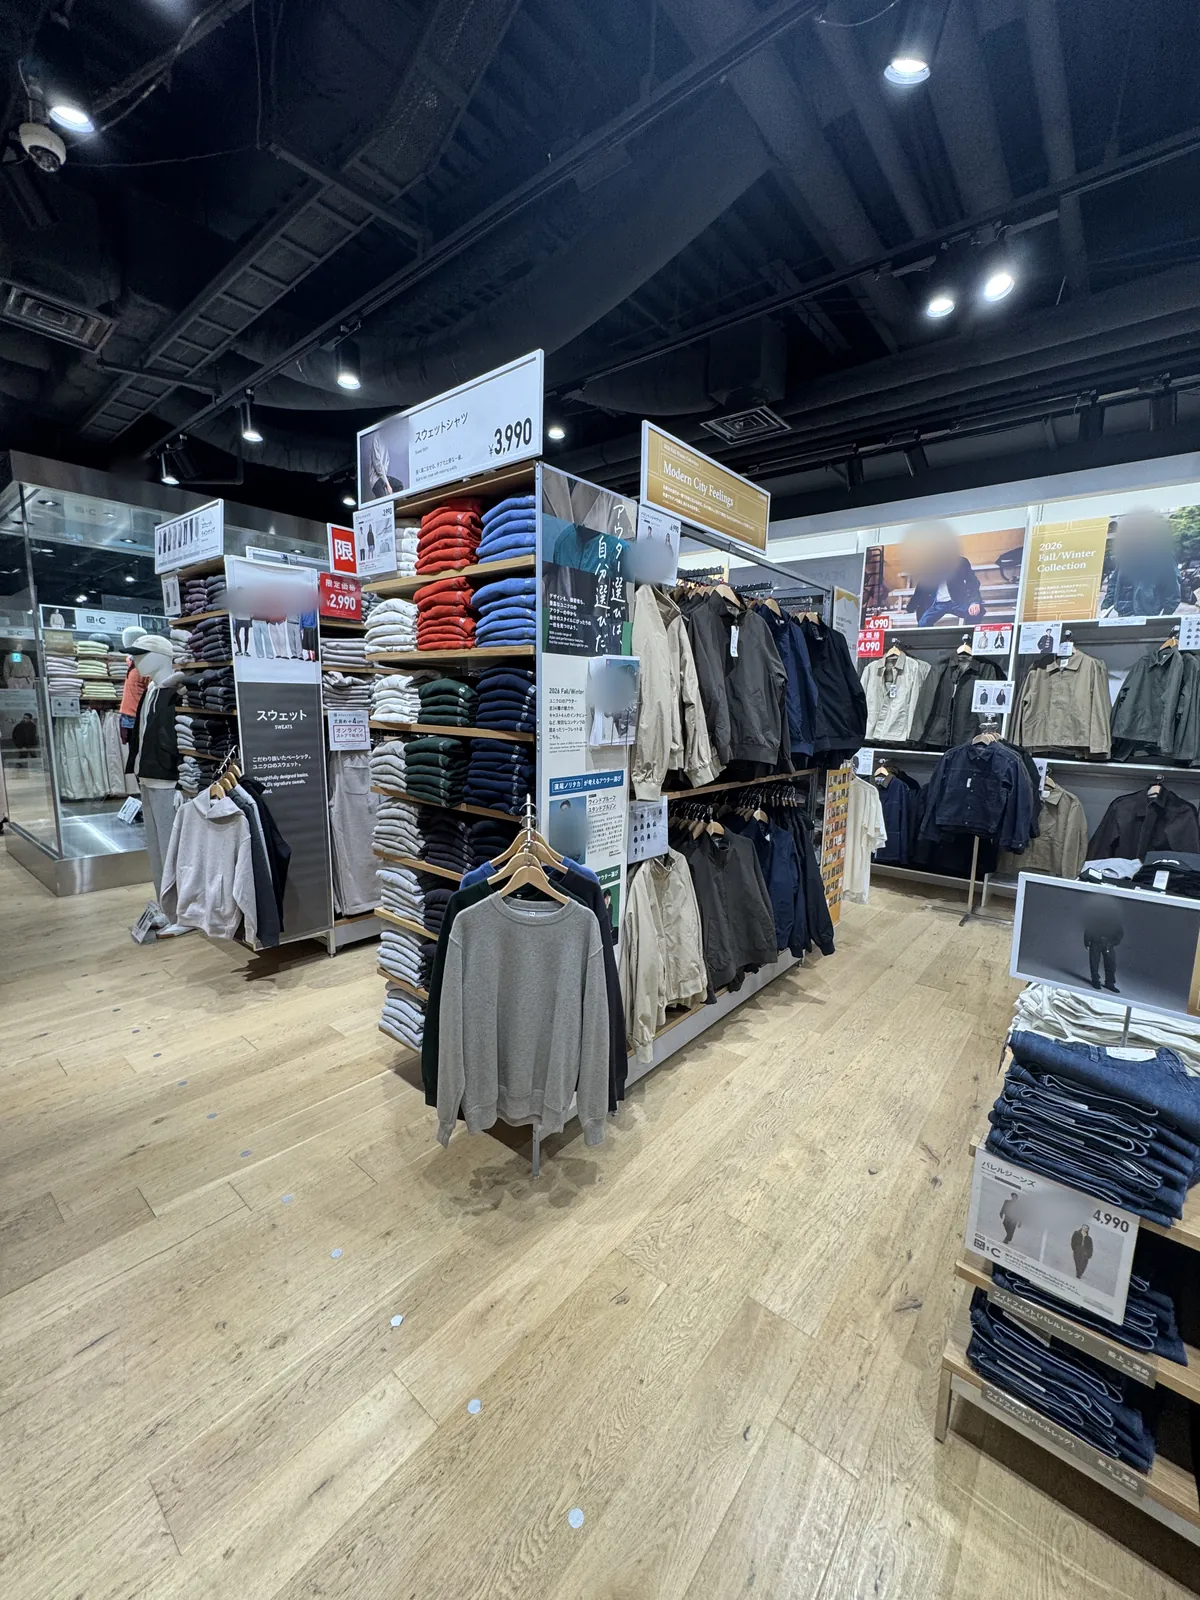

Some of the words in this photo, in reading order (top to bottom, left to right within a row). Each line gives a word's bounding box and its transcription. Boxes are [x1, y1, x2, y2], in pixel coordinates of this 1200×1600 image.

[415, 412, 468, 443] スウェットシャツ
[488, 417, 532, 457] ¥3,990
[663, 460, 692, 486] Modern
[693, 477, 708, 496] City
[708, 485, 734, 508] Feelings
[334, 538, 354, 562] 限
[1039, 541, 1063, 551] 2026
[1038, 550, 1096, 562] Fall/Winter
[1037, 561, 1087, 573] Collection
[325, 578, 356, 592] 限定価格
[327, 593, 356, 611] ¥2,990
[256, 709, 307, 721] スウェット
[252, 753, 311, 763] こだわり抜いたベーシック。
[252, 761, 302, 770] ユニクロのスウェット。
[981, 1161, 1036, 1188] バレルジーンズ
